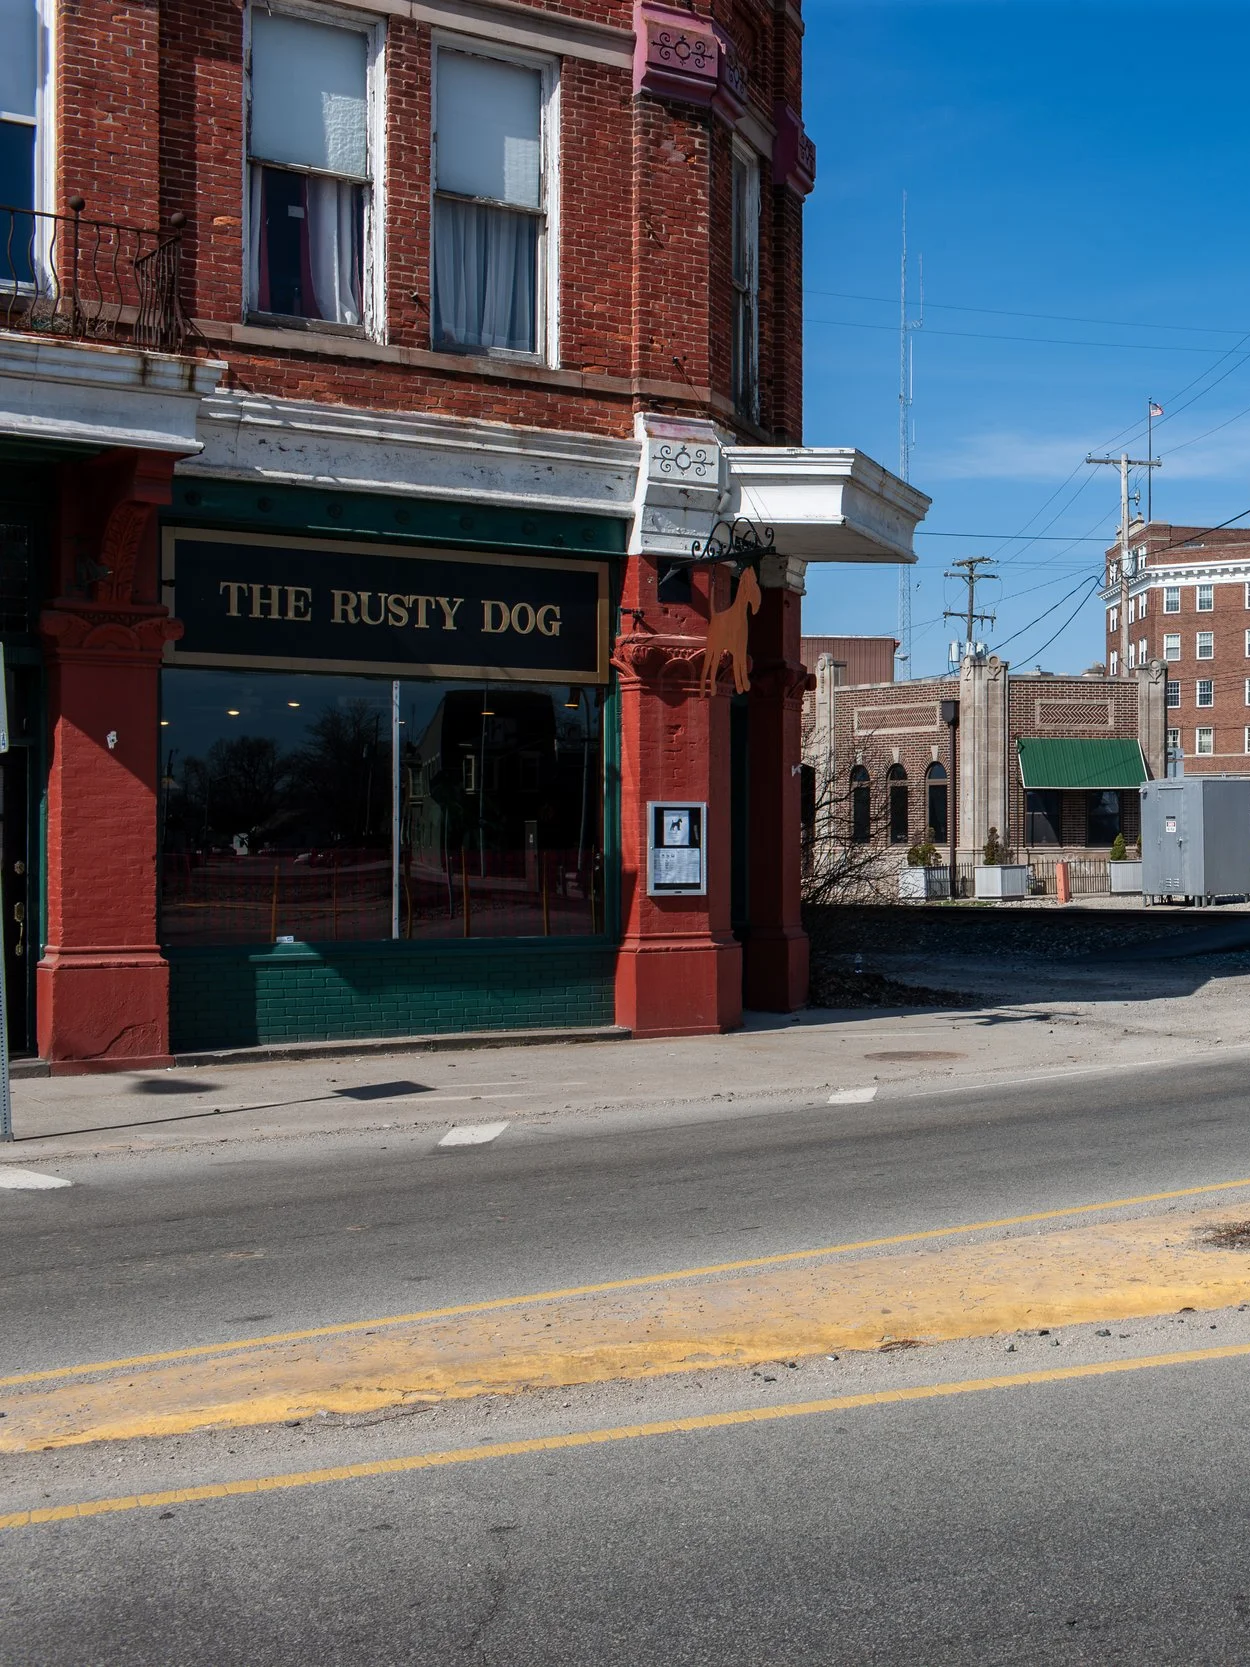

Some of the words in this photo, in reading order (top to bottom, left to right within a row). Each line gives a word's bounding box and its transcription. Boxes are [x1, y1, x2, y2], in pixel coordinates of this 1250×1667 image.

[219, 581, 312, 622] THE
[330, 589, 465, 630] RUSTY
[480, 600, 563, 637] DOG
